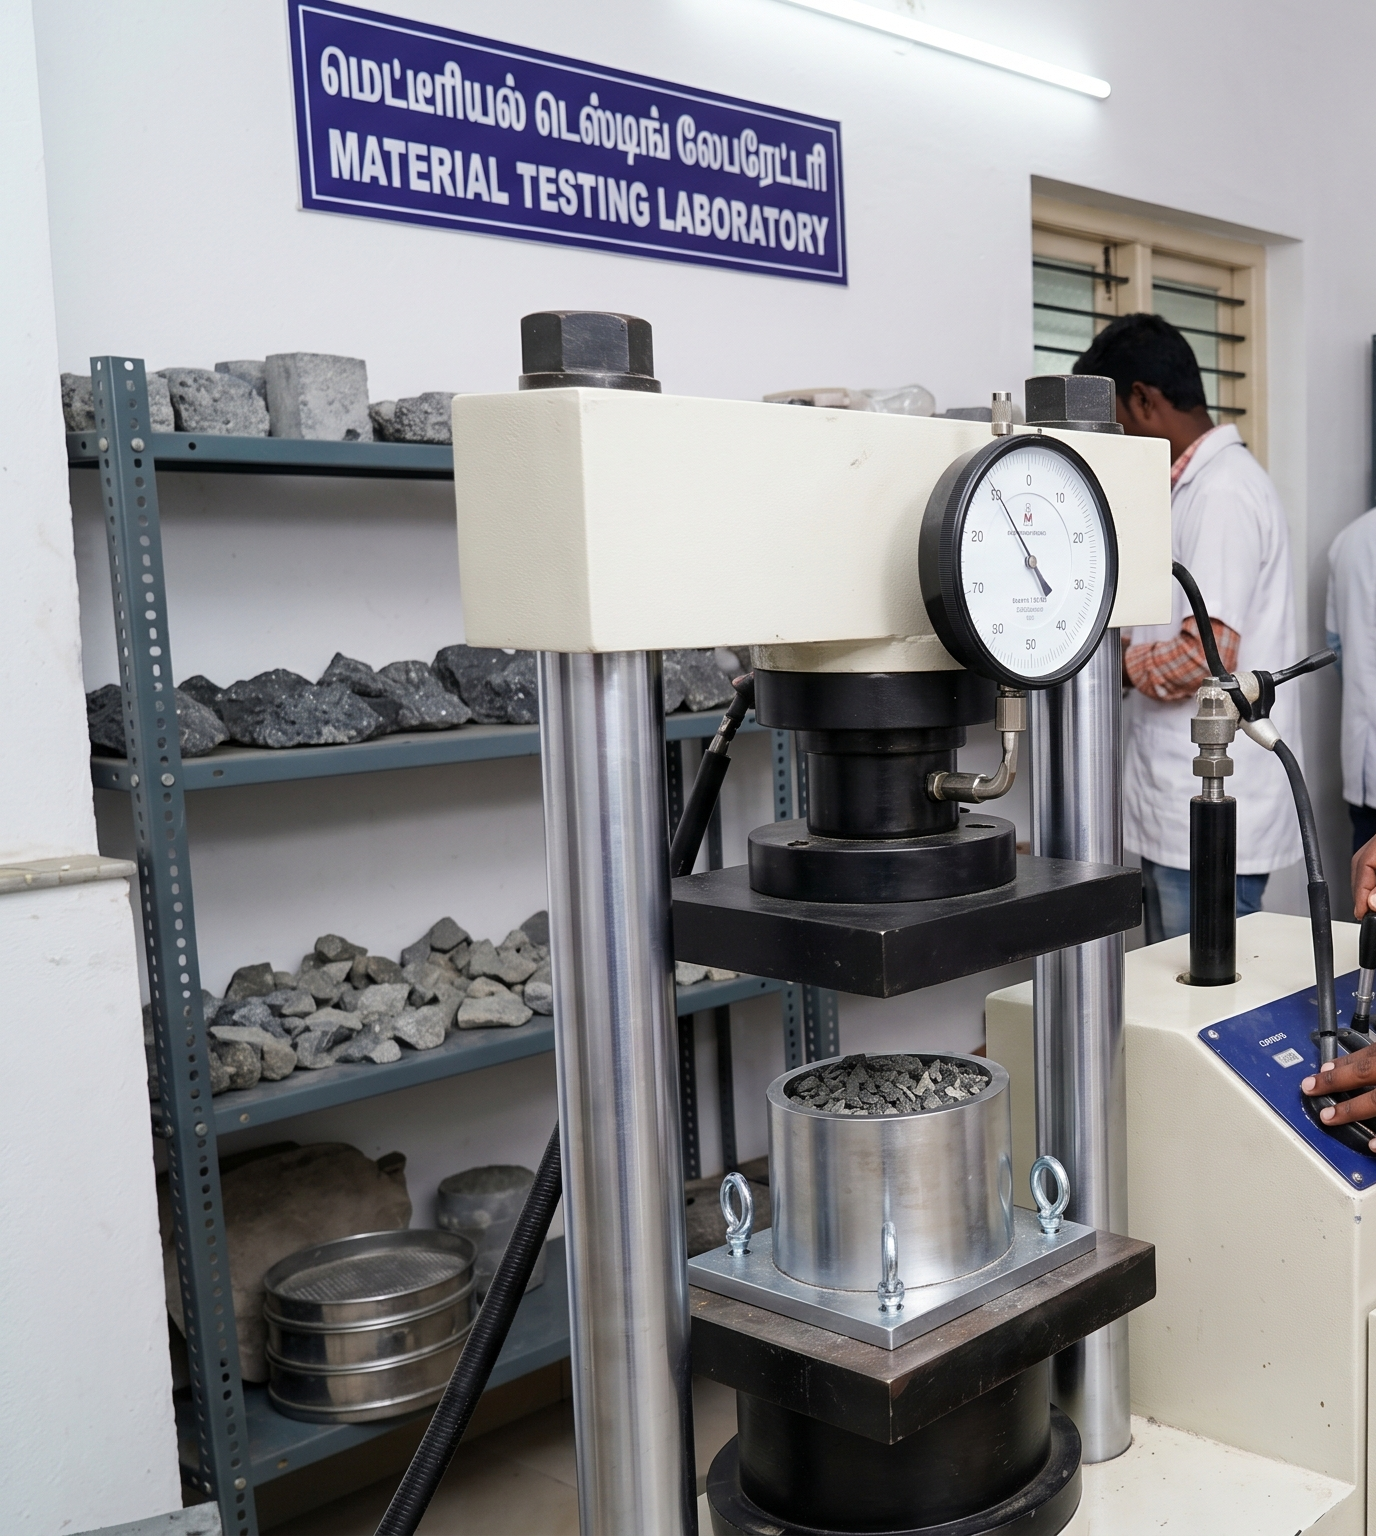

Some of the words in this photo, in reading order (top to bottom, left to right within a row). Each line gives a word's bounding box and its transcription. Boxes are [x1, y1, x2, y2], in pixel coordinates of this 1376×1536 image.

[534, 90, 671, 166] டெஸ்டிங்
[676, 113, 828, 193] லேபரேட்டரி
[328, 128, 509, 206] MATERIAL
[515, 161, 651, 228] TESTING
[657, 186, 830, 256] LABORATORY
[1026, 474, 1032, 486] 0
[1055, 492, 1065, 503] 10
[971, 530, 984, 543] 20
[1072, 532, 1084, 544] 20
[972, 582, 984, 594] 70
[1073, 579, 1085, 590] 30
[1055, 620, 1067, 631] 40
[1025, 638, 1037, 650] 50
